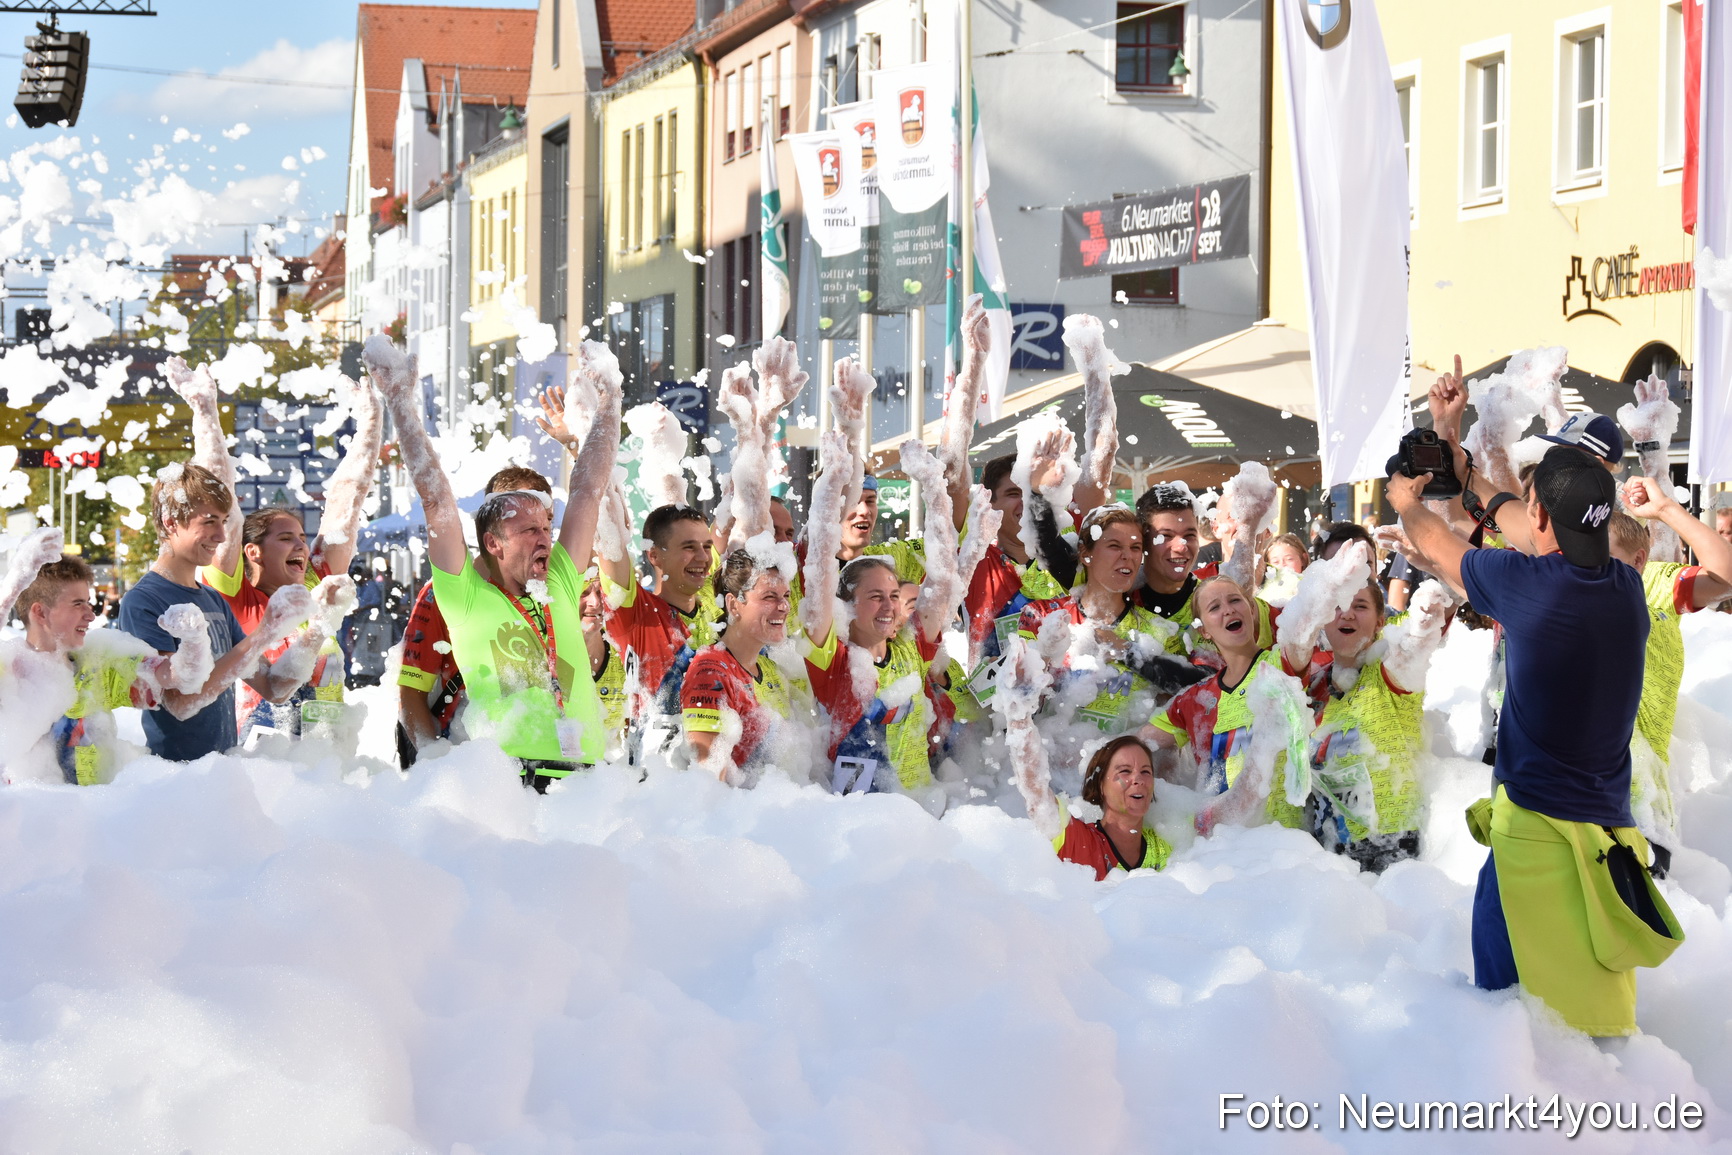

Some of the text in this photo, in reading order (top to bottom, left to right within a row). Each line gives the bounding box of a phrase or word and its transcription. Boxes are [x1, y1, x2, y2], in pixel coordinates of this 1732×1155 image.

[1201, 189, 1221, 228] 28.
[1107, 227, 1195, 265] KULTURNACHT
[1198, 230, 1222, 255] SEPT.
[841, 762, 865, 797] 7
